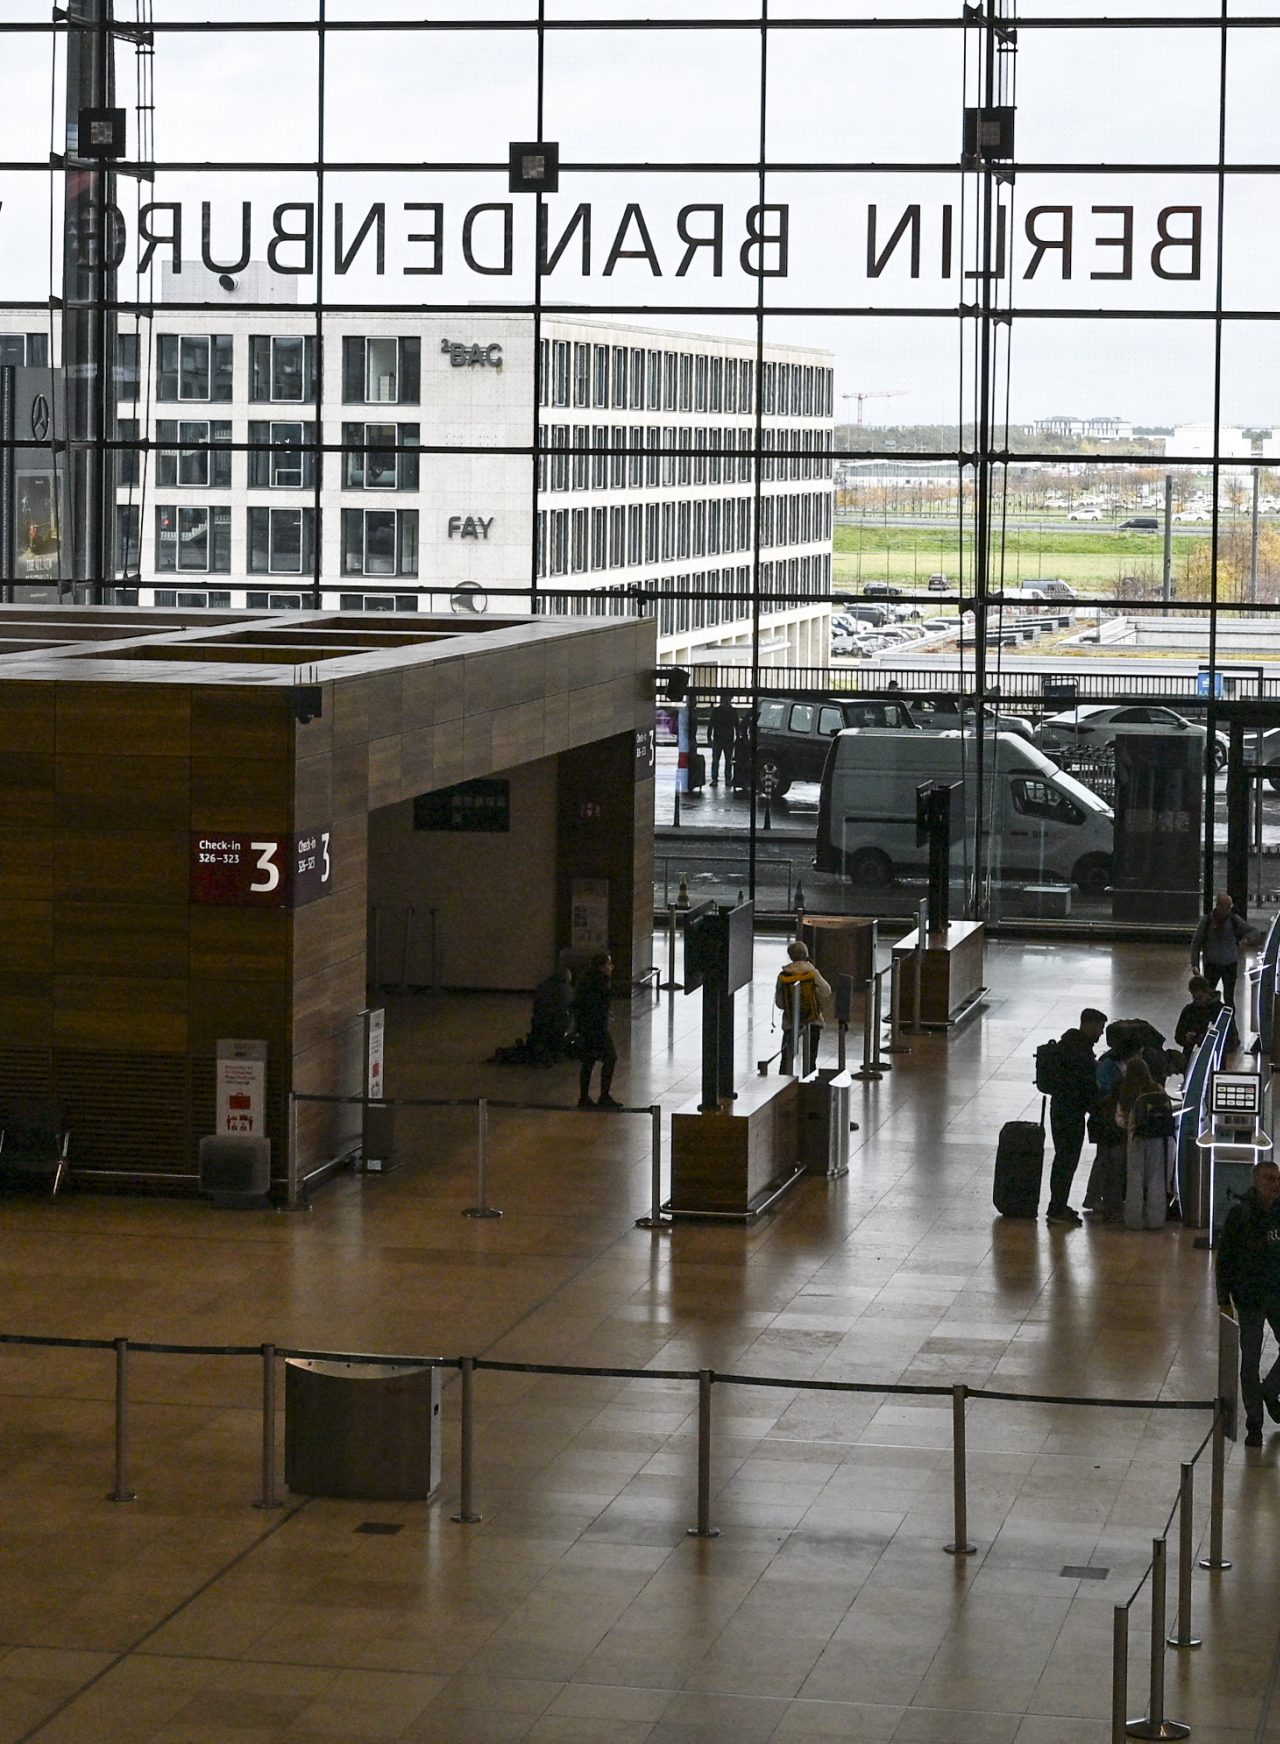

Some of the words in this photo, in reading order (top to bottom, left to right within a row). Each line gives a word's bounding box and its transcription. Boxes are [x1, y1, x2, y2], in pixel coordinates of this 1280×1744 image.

[448, 516, 494, 540] FAY
[199, 840, 241, 851] Check-in
[298, 836, 317, 854] Check-in
[250, 842, 280, 893] 3
[320, 832, 330, 883] 3
